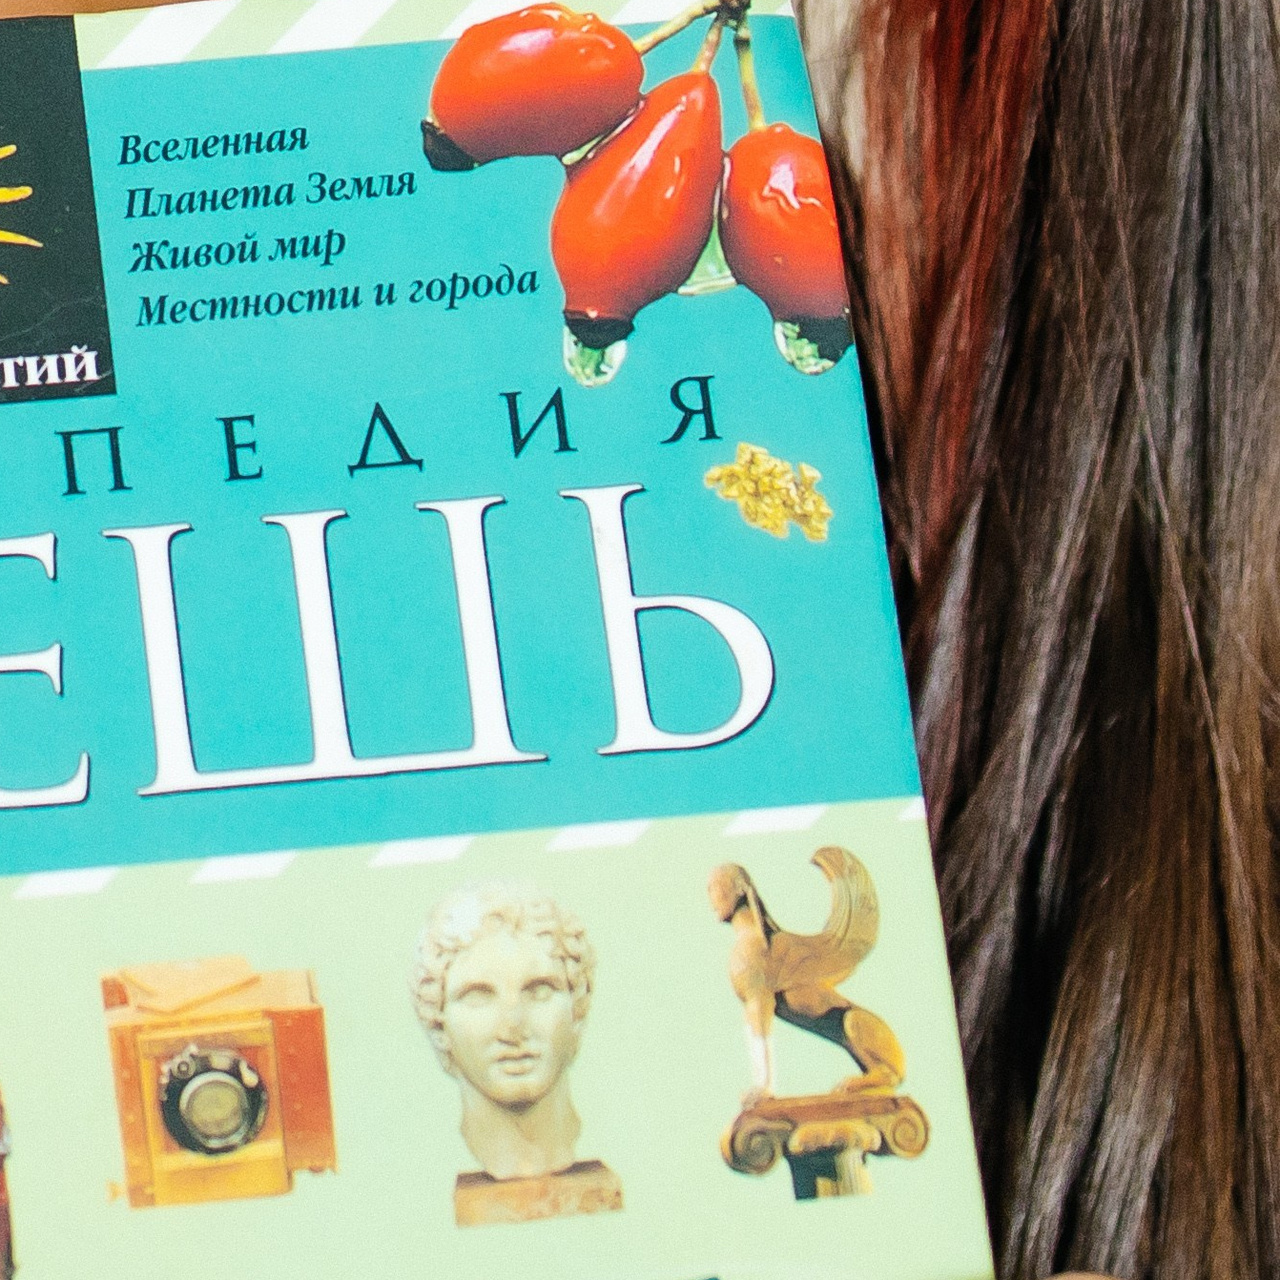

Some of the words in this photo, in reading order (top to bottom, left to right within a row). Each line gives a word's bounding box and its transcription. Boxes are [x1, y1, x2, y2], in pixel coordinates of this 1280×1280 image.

[118, 126, 309, 166] Вселенная
[124, 182, 296, 219] Планета
[305, 170, 418, 205] Земля
[128, 231, 261, 273] Живой
[267, 228, 347, 267] мир
[135, 284, 362, 328] Местности
[374, 281, 398, 306] и
[408, 264, 541, 310] города
